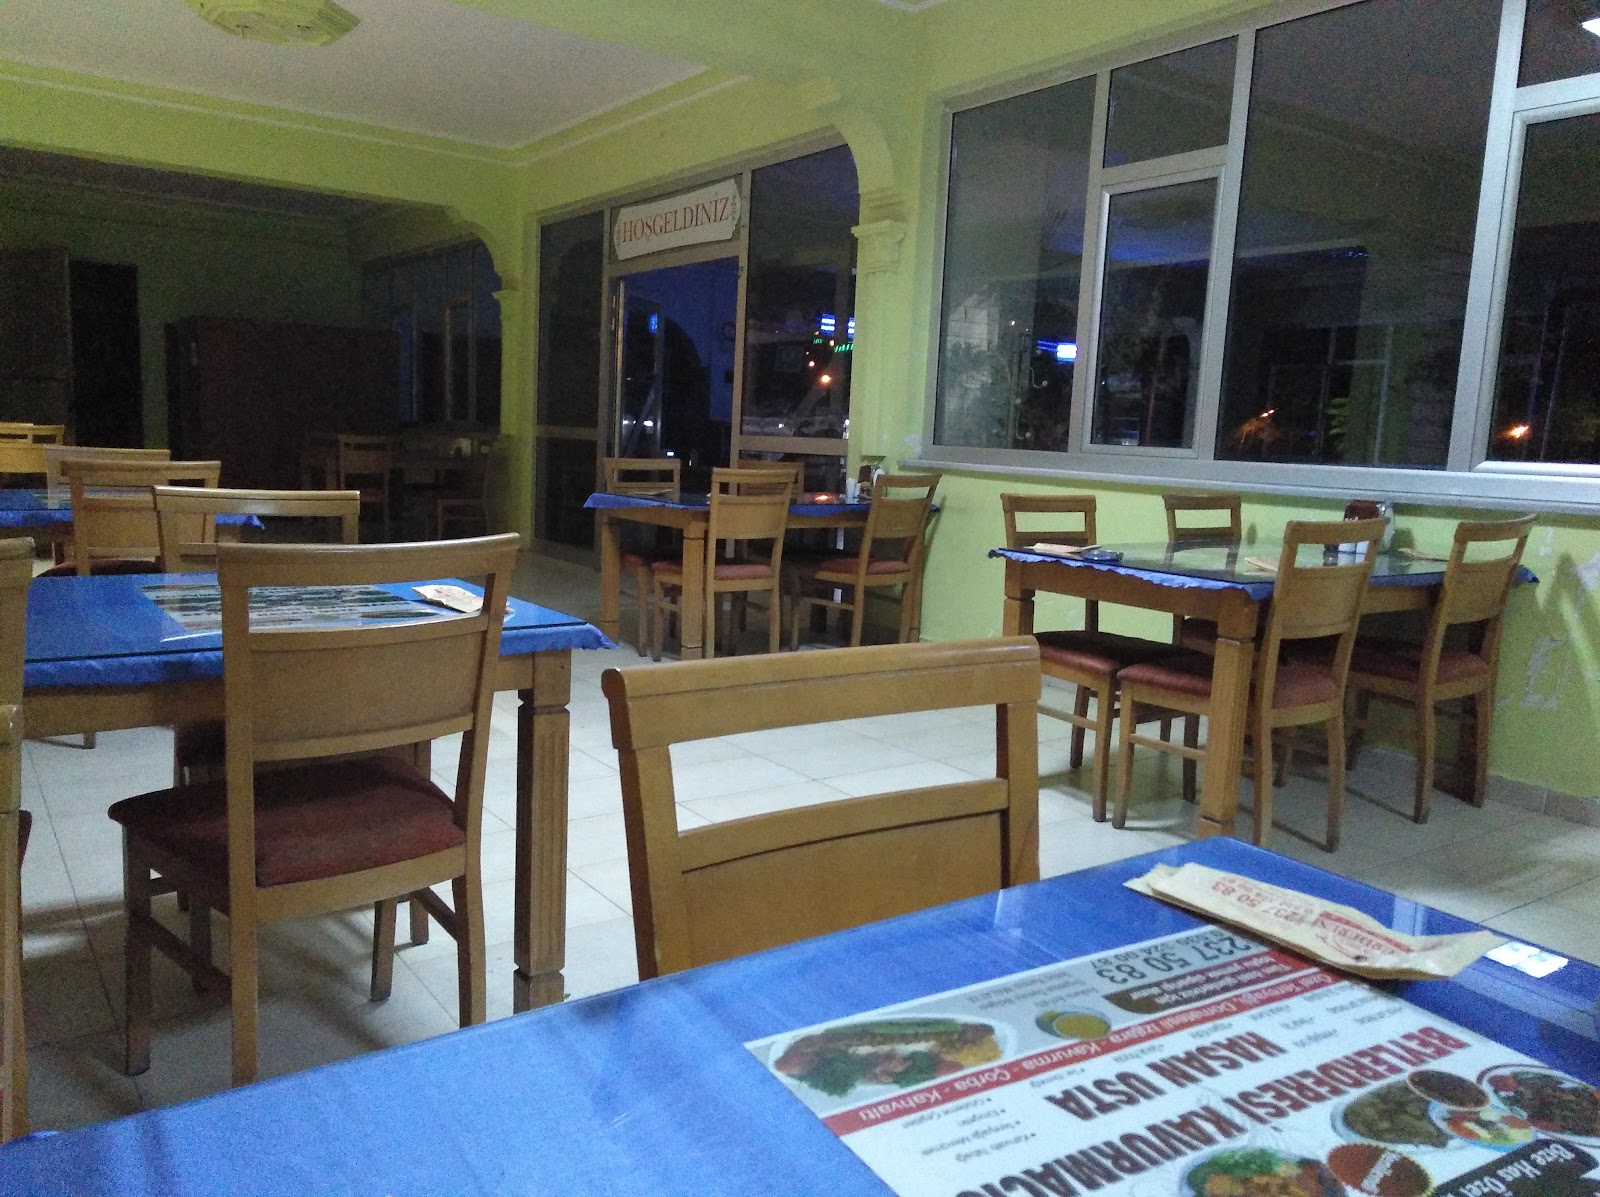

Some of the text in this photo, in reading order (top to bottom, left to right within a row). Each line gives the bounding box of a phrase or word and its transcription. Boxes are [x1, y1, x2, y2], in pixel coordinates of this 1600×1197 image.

[1091, 936, 1257, 985] 237 50 83
[1018, 1041, 1104, 1071] Kavurma
[1141, 1030, 1291, 1088] HASAN
[947, 1066, 1016, 1093] Çorba
[855, 1088, 948, 1124] Kahvaltı
[1042, 1070, 1169, 1123] USTA
[1491, 1159, 1546, 1185] Has
[1523, 1142, 1579, 1169] Bize
